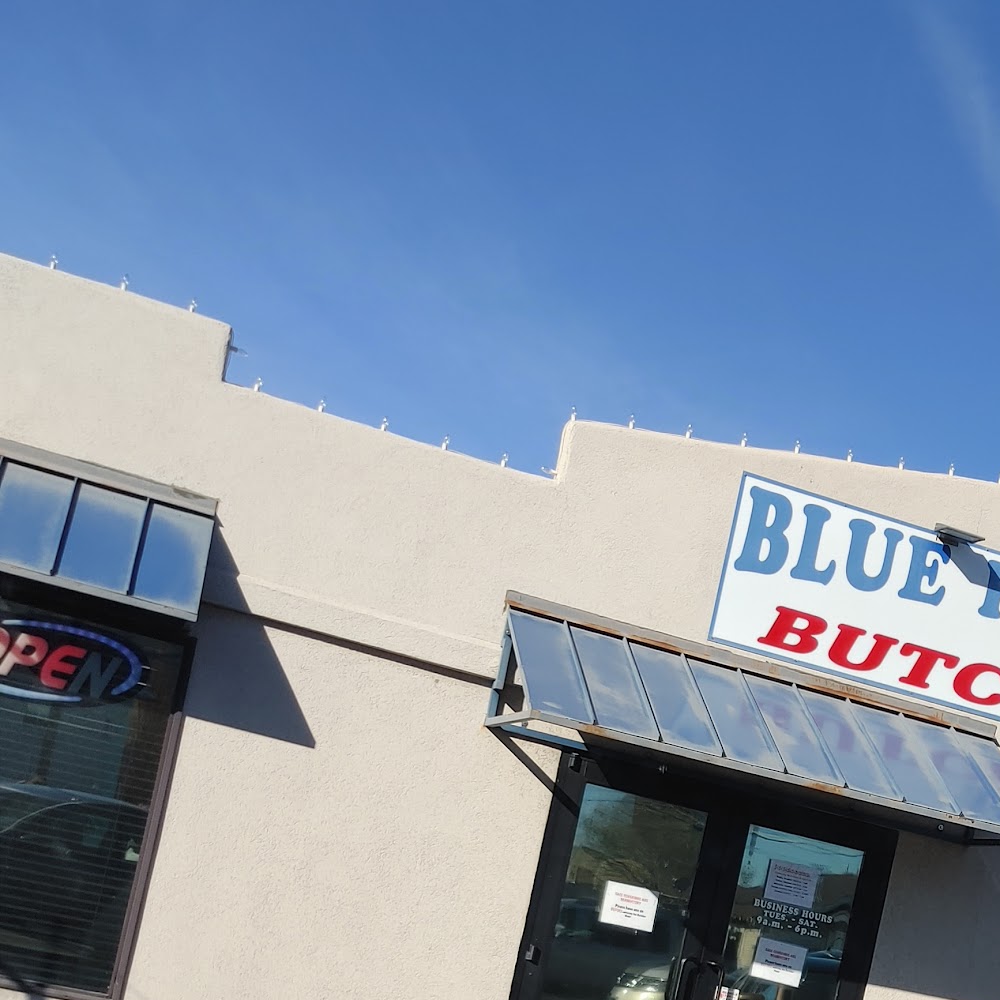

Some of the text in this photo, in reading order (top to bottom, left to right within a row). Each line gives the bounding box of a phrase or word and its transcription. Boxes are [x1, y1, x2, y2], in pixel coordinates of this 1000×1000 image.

[734, 486, 949, 605] BLUE
[753, 898, 833, 924] BUSINESS HOURS
[763, 910, 788, 922] TUES.
[798, 918, 818, 929] SAT.
